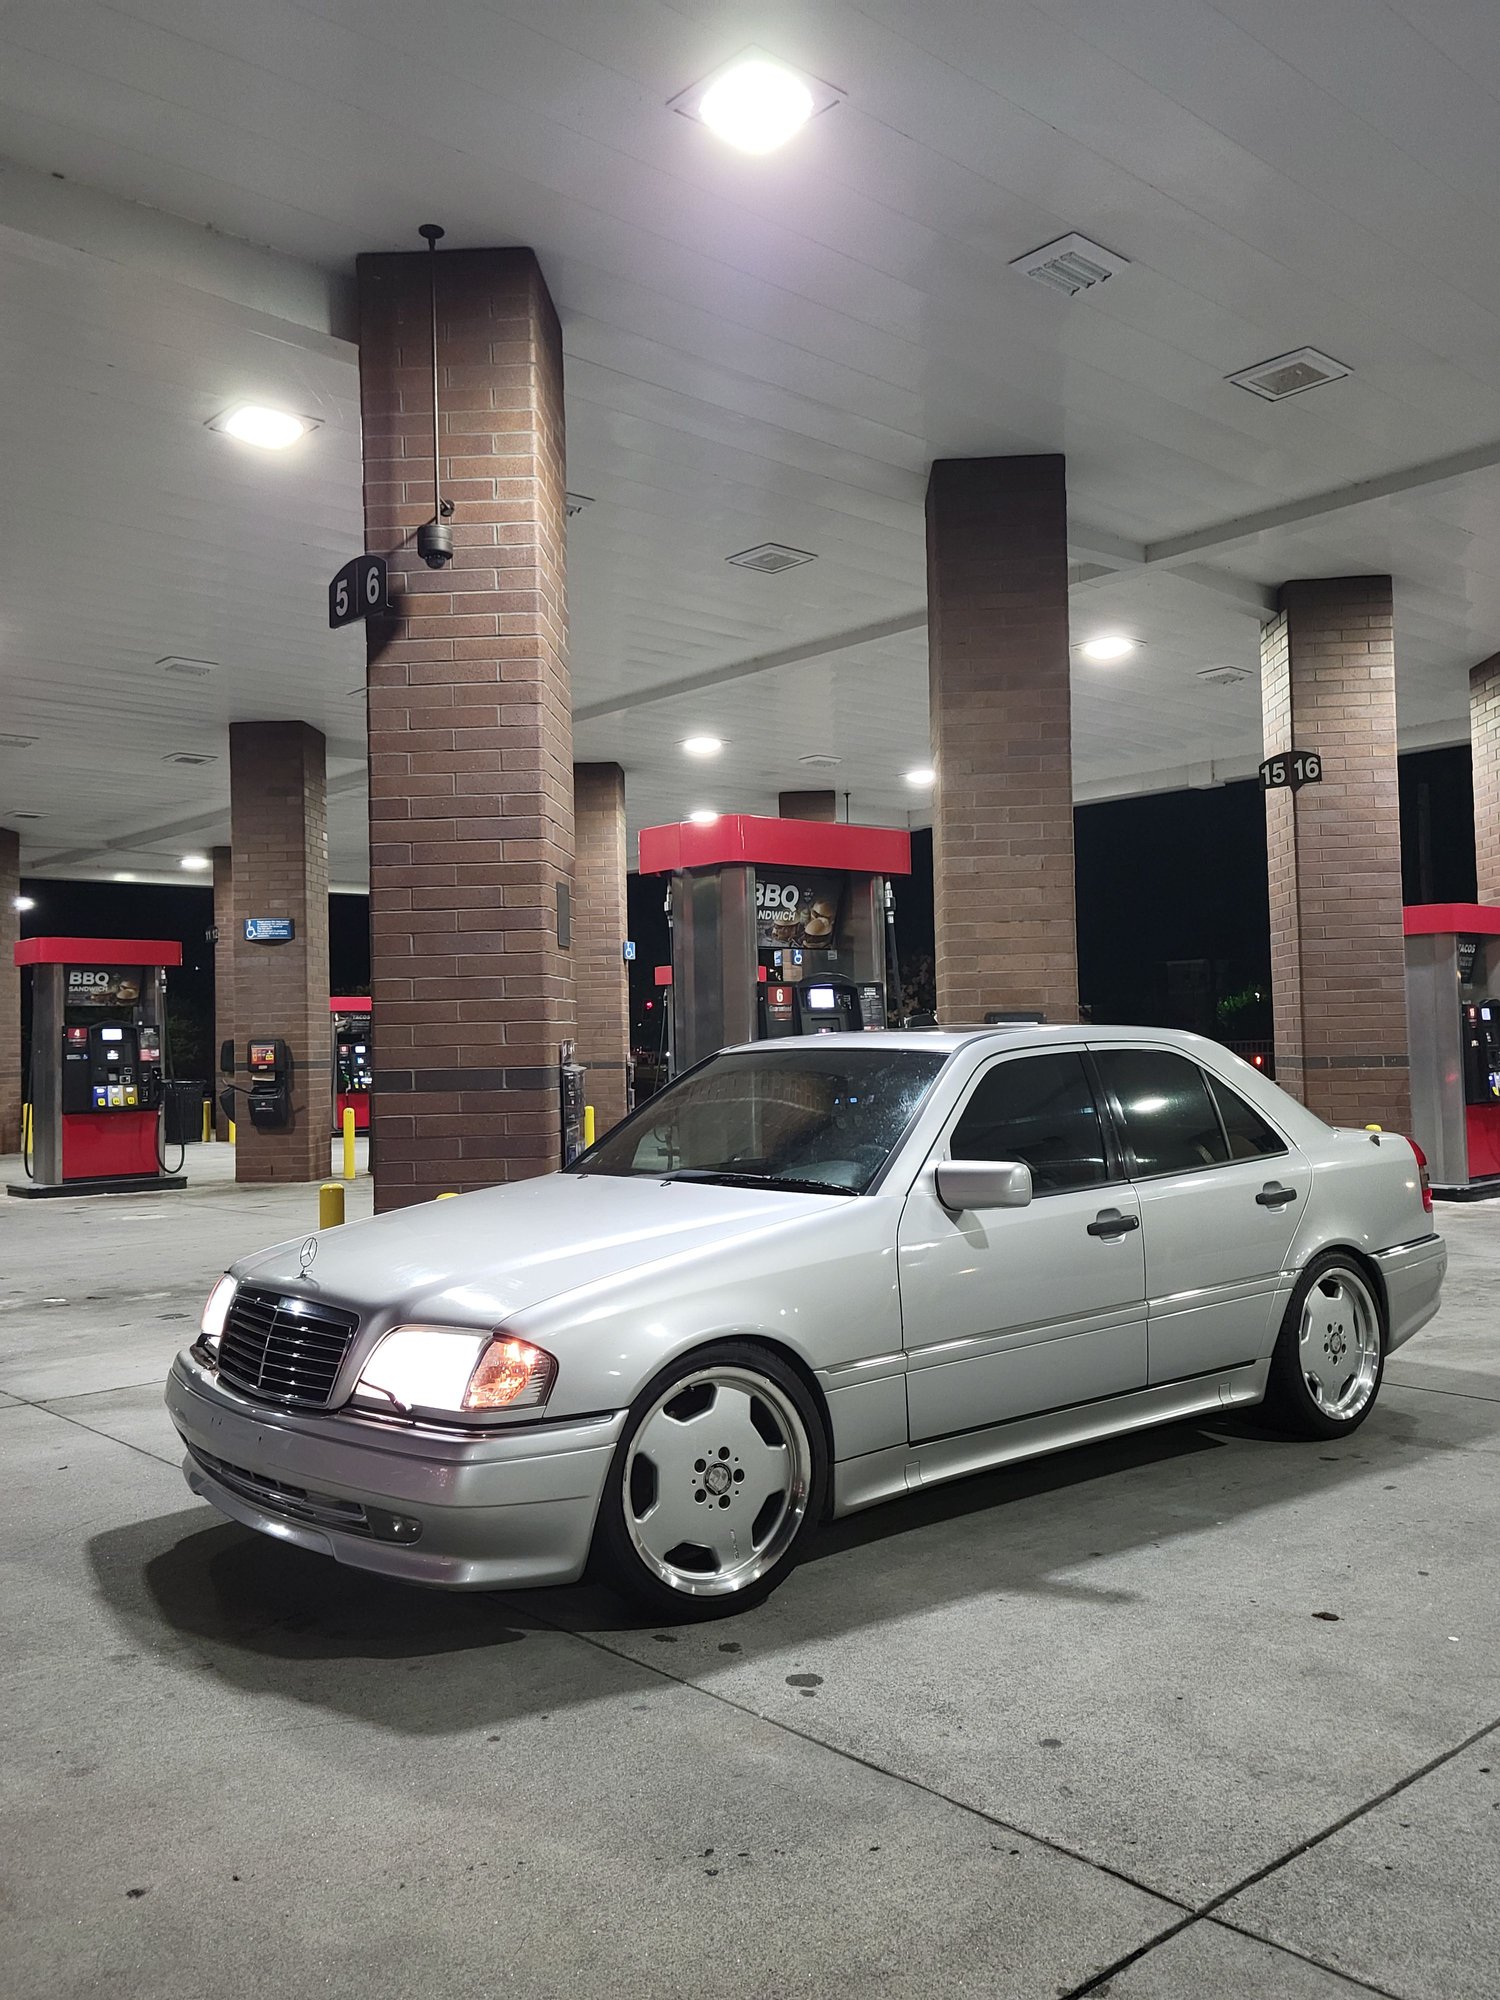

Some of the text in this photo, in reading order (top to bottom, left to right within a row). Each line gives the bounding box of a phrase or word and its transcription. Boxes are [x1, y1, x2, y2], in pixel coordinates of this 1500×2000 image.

[336, 566, 380, 616] 5 6
[1261, 756, 1319, 785] 15 16
[757, 910, 796, 921] NDWICH
[69, 971, 110, 987] BBQ
[776, 988, 784, 1003] 6
[74, 1029, 80, 1037] 4
